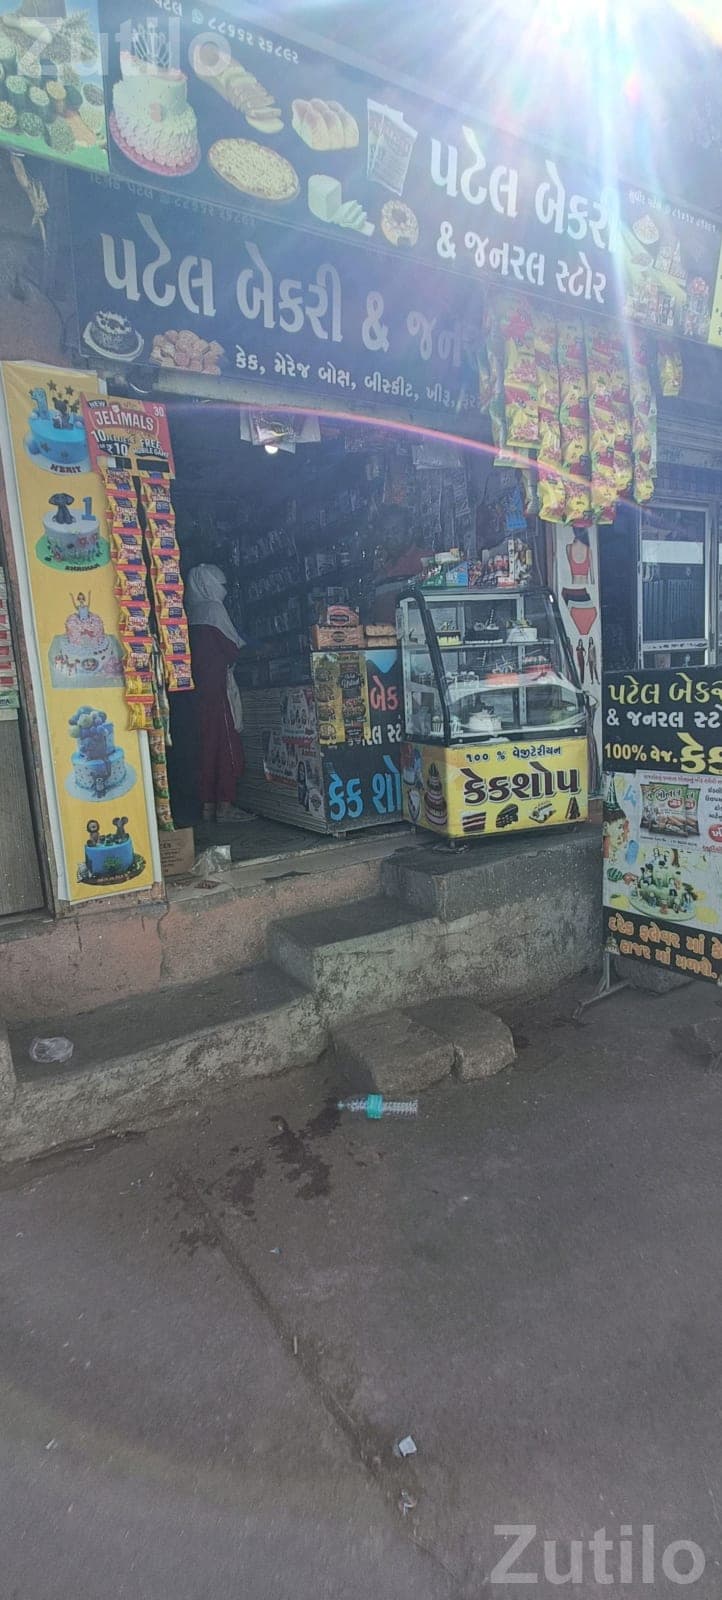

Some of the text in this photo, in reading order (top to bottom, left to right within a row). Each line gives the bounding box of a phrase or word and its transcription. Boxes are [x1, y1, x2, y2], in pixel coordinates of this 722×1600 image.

[430, 125, 519, 219] પટેલ
[436, 220, 607, 304] & જનરલ સ્ટોર
[100, 212, 217, 317] પટેલ
[236, 241, 344, 343] બેકરી
[361, 290, 391, 353] &
[234, 345, 266, 376] કેક,
[274, 351, 311, 379] મેરેજ
[153, 406, 166, 417] 30
[91, 429, 106, 443] 10
[370, 675, 400, 712] બેક
[608, 675, 661, 705] પટેલ
[606, 708, 620, 726] &
[626, 711, 684, 729] જનરલ
[604, 742, 648, 762] 100%
[325, 758, 365, 822] કેક
[460, 761, 581, 806] કેકશોપ
[608, 912, 635, 937] દરેક
